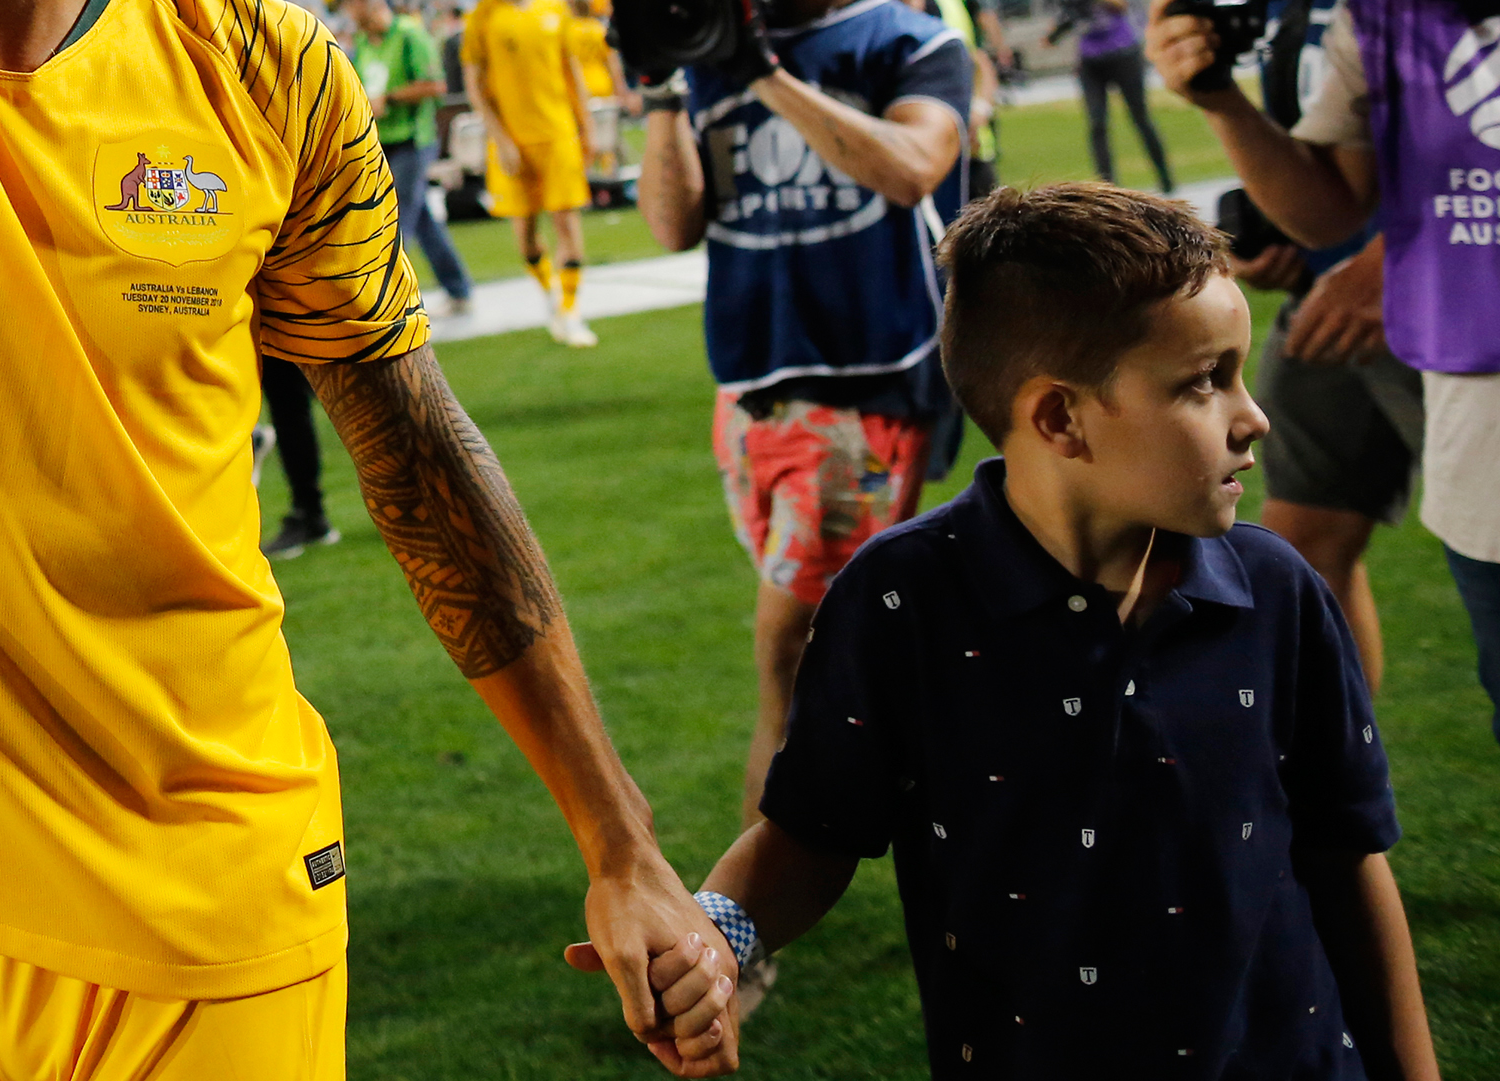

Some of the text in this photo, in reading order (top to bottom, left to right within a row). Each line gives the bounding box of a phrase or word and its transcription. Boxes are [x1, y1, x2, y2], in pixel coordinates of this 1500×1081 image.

[1449, 167, 1500, 192] FO
[1434, 194, 1500, 218] FED
[125, 213, 217, 226] AUSTRALIA
[1449, 221, 1500, 245] AU
[130, 283, 174, 293] AUSTRALIA
[186, 286, 218, 297] LEBANON
[121, 292, 159, 302] TUESDAY
[160, 295, 169, 303] 20
[170, 296, 209, 306] NOVEMBER
[138, 304, 210, 317] SYDNEY, AUSTRALIA
